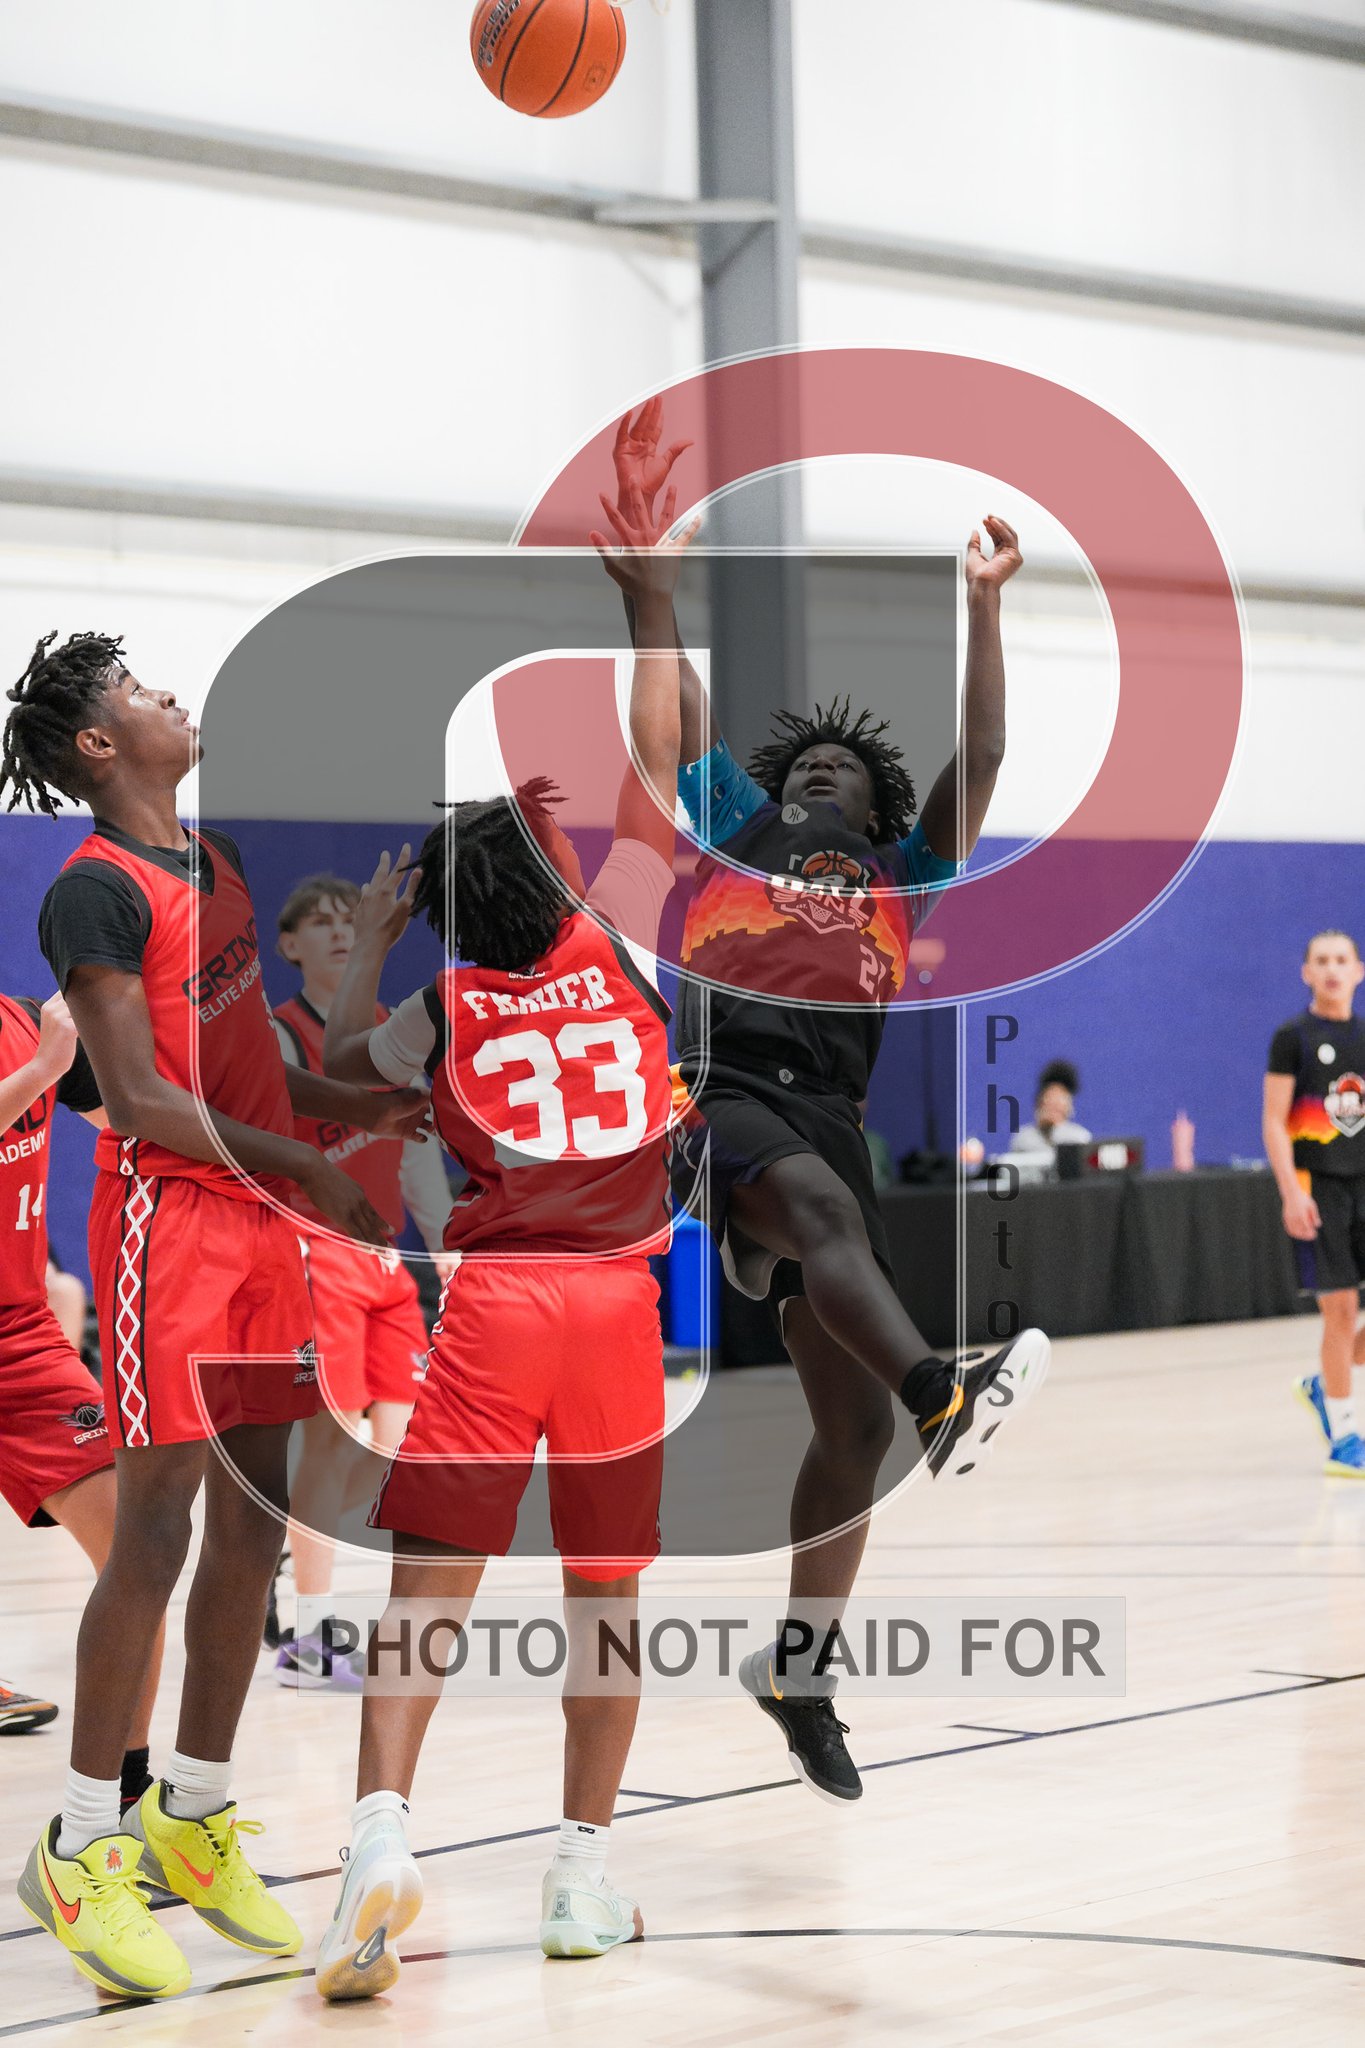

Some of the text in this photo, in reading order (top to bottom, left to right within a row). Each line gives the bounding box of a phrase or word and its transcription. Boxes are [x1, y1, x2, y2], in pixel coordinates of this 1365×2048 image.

[199, 984, 240, 1024] ELITE
[472, 1017, 648, 1169] 33
[15, 1183, 43, 1231] 14
